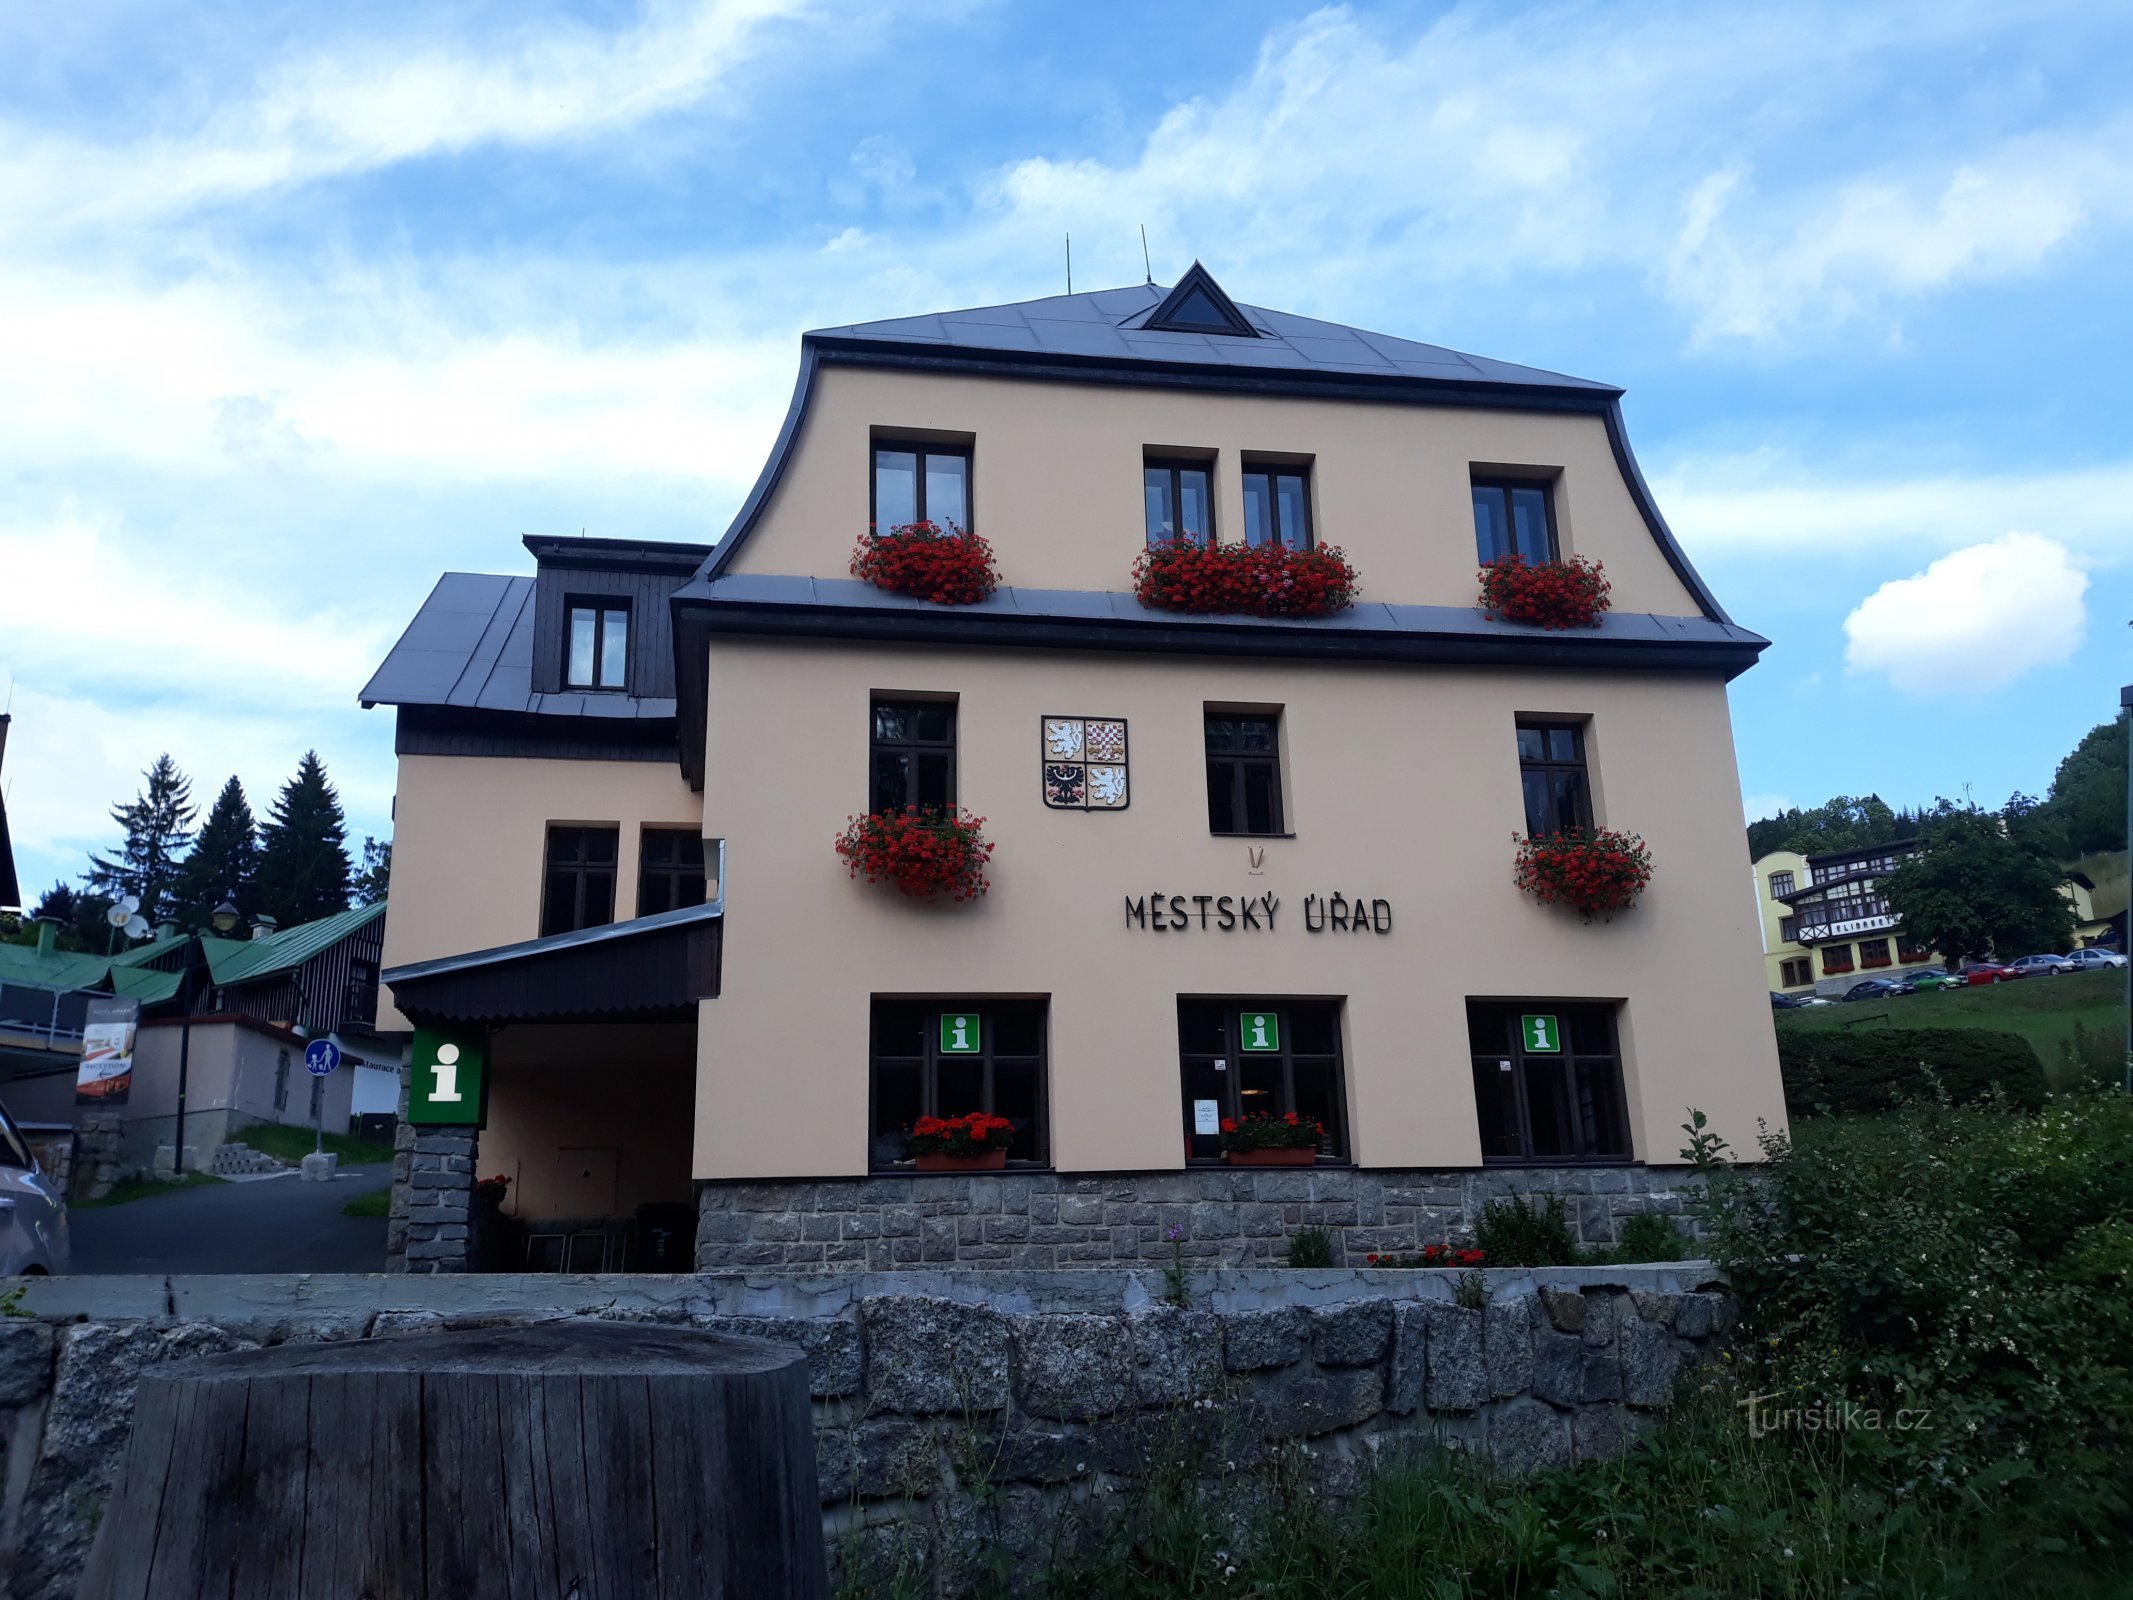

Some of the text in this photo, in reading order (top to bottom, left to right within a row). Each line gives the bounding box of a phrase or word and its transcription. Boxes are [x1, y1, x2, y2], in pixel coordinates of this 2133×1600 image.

[1125, 890, 1392, 934] MĚSTSKÝ ÚŘAD
[85, 1062, 126, 1070] RECEPTION
